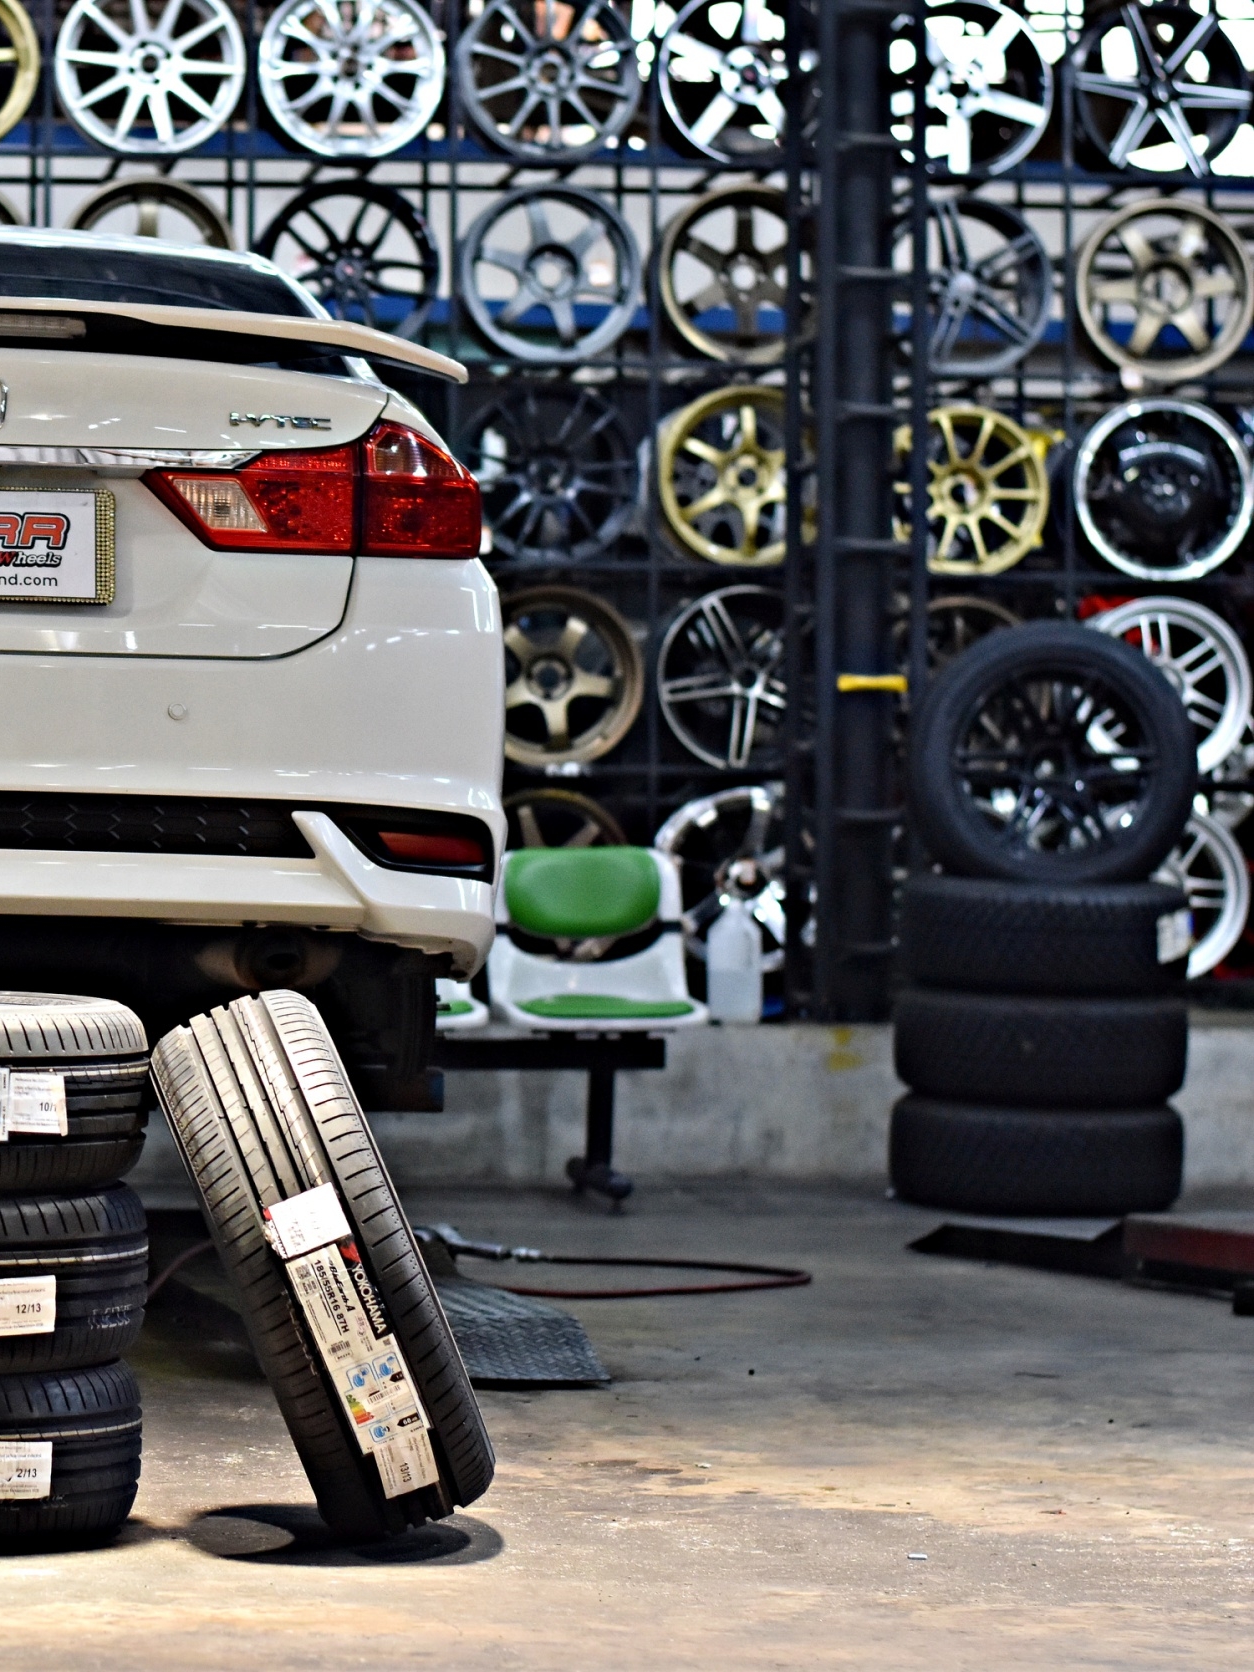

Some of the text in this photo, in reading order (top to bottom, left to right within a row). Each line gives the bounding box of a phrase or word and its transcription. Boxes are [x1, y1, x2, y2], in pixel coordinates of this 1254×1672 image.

[16, 1303, 41, 1314] 12/13
[314, 1259, 350, 1333] 185/55R16 87H
[351, 1263, 387, 1334] YOKOHAMA
[399, 1462, 412, 1483] 13/13
